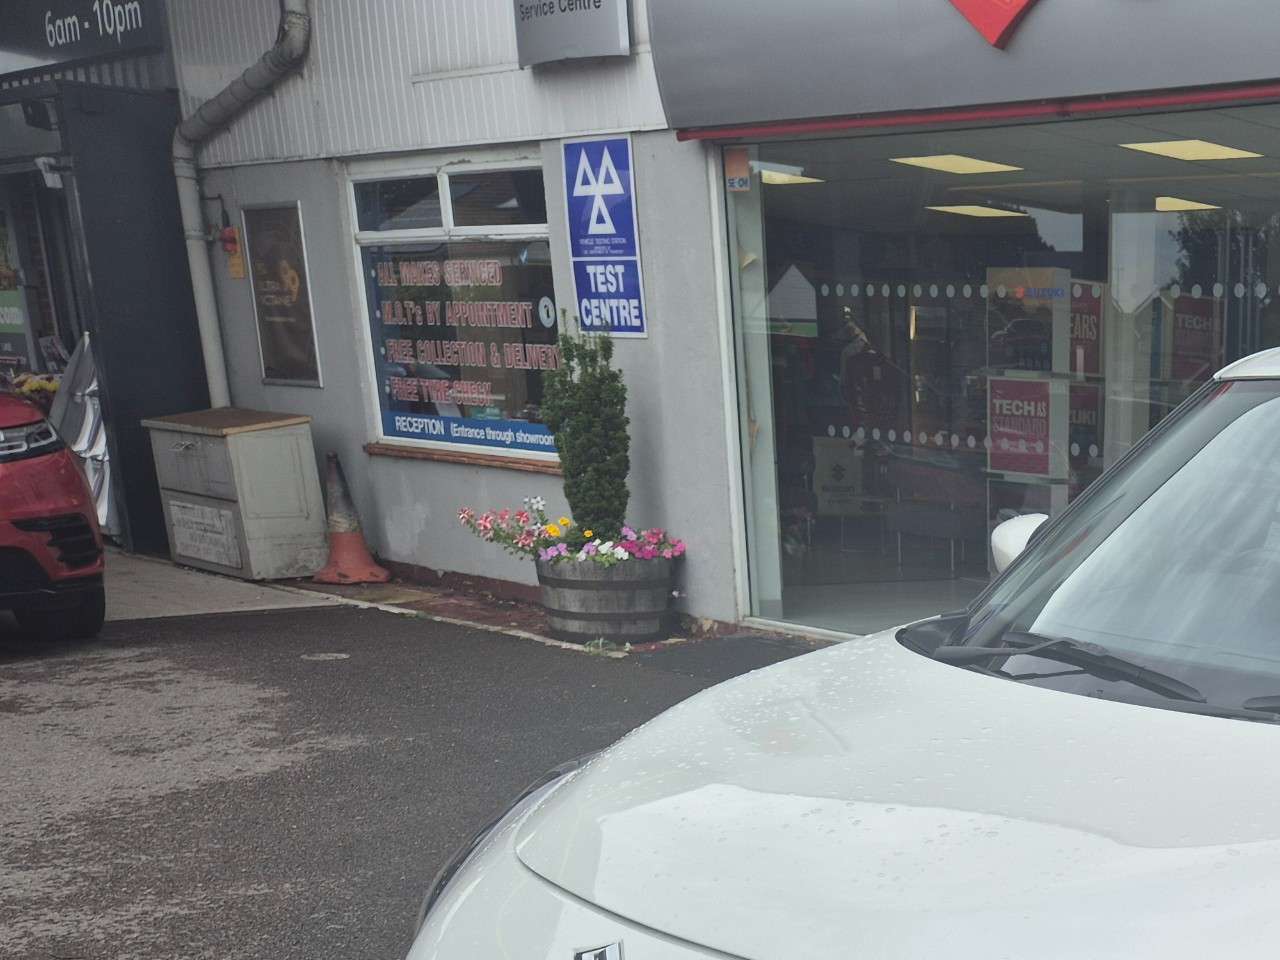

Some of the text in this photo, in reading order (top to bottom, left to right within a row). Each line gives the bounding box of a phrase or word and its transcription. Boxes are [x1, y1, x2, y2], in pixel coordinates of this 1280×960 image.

[45, 10, 80, 47] 6am
[93, 0, 142, 44] 10pm
[520, 0, 601, 21] Service Centre
[377, 261, 398, 287] ALL
[399, 261, 441, 287] MAKES
[586, 264, 625, 293] TEST
[426, 300, 441, 326] BY
[445, 301, 533, 328] APPOINTMENT
[581, 298, 641, 327] CENTRE
[385, 339, 416, 364] FREE
[416, 340, 487, 368] COLLECTION
[503, 342, 561, 371] DELIVERY
[390, 376, 419, 402] FREE
[993, 399, 1036, 417] TECH
[395, 415, 445, 436] RECEPTION
[486, 427, 515, 445] through
[992, 415, 1047, 435] STANDARD
